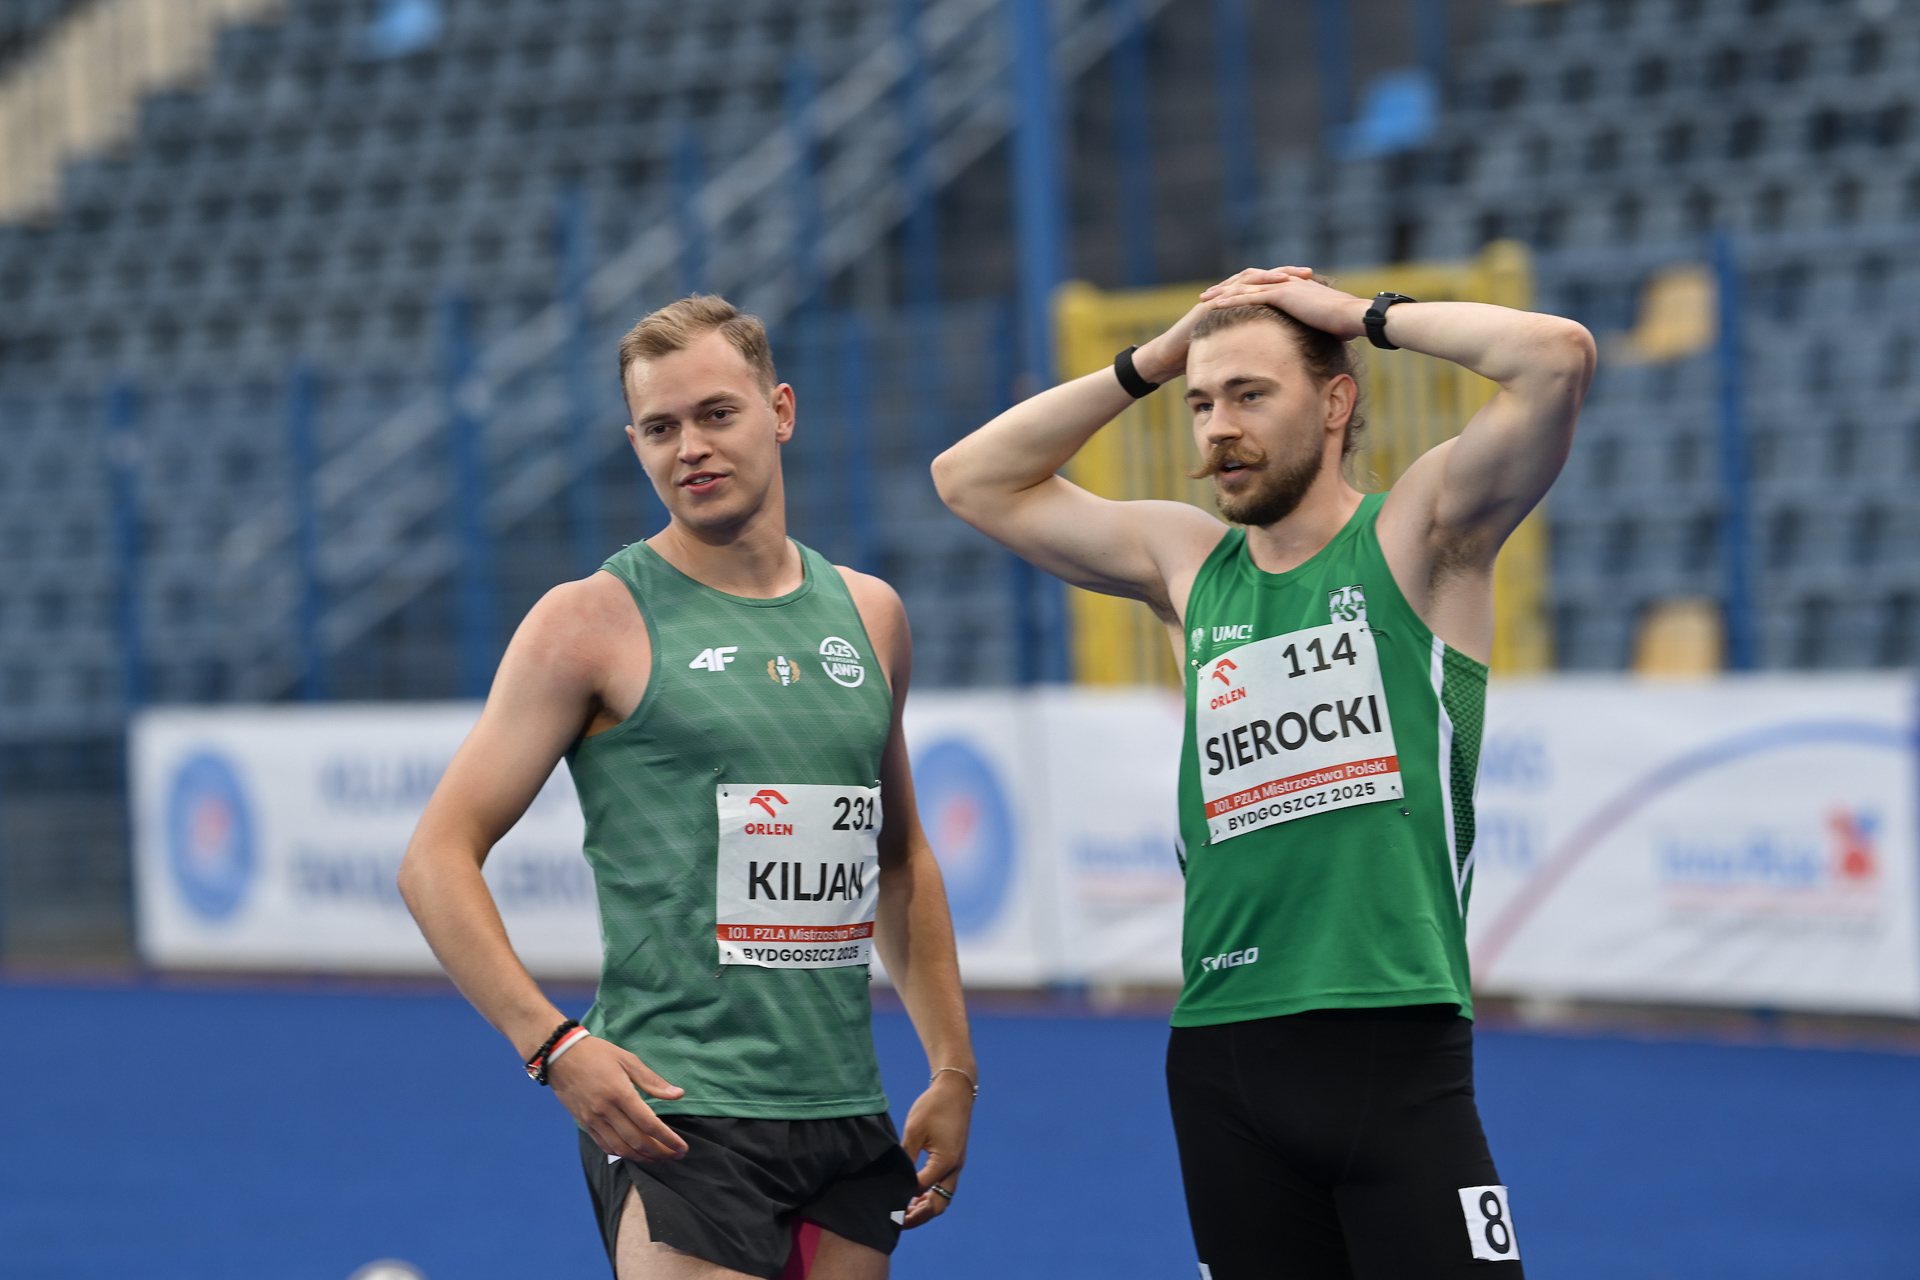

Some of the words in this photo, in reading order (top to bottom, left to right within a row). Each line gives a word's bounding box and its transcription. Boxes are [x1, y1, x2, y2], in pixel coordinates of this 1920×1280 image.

[827, 643, 852, 658] AZS
[1282, 632, 1357, 679] 114
[832, 662, 859, 678] AWF
[1210, 686, 1246, 710] ORLEN
[1206, 694, 1383, 776] SIEROCKI
[1234, 790, 1262, 807] PZLA
[1262, 769, 1344, 799] Mistrzostwa
[1346, 759, 1388, 778] Polski
[832, 796, 874, 831] 231
[1228, 791, 1328, 831] BYDGOSZCZ
[1331, 781, 1377, 802] 2025
[744, 822, 793, 836] ORLEN
[748, 861, 865, 902] KILJAN
[728, 926, 751, 940] 101.
[753, 928, 788, 941] PZLA
[789, 926, 849, 941] Mistrzostwa
[743, 948, 838, 963] BYDGOSZCZ
[836, 945, 860, 960] 2025
[1479, 1190, 1511, 1255] 8
